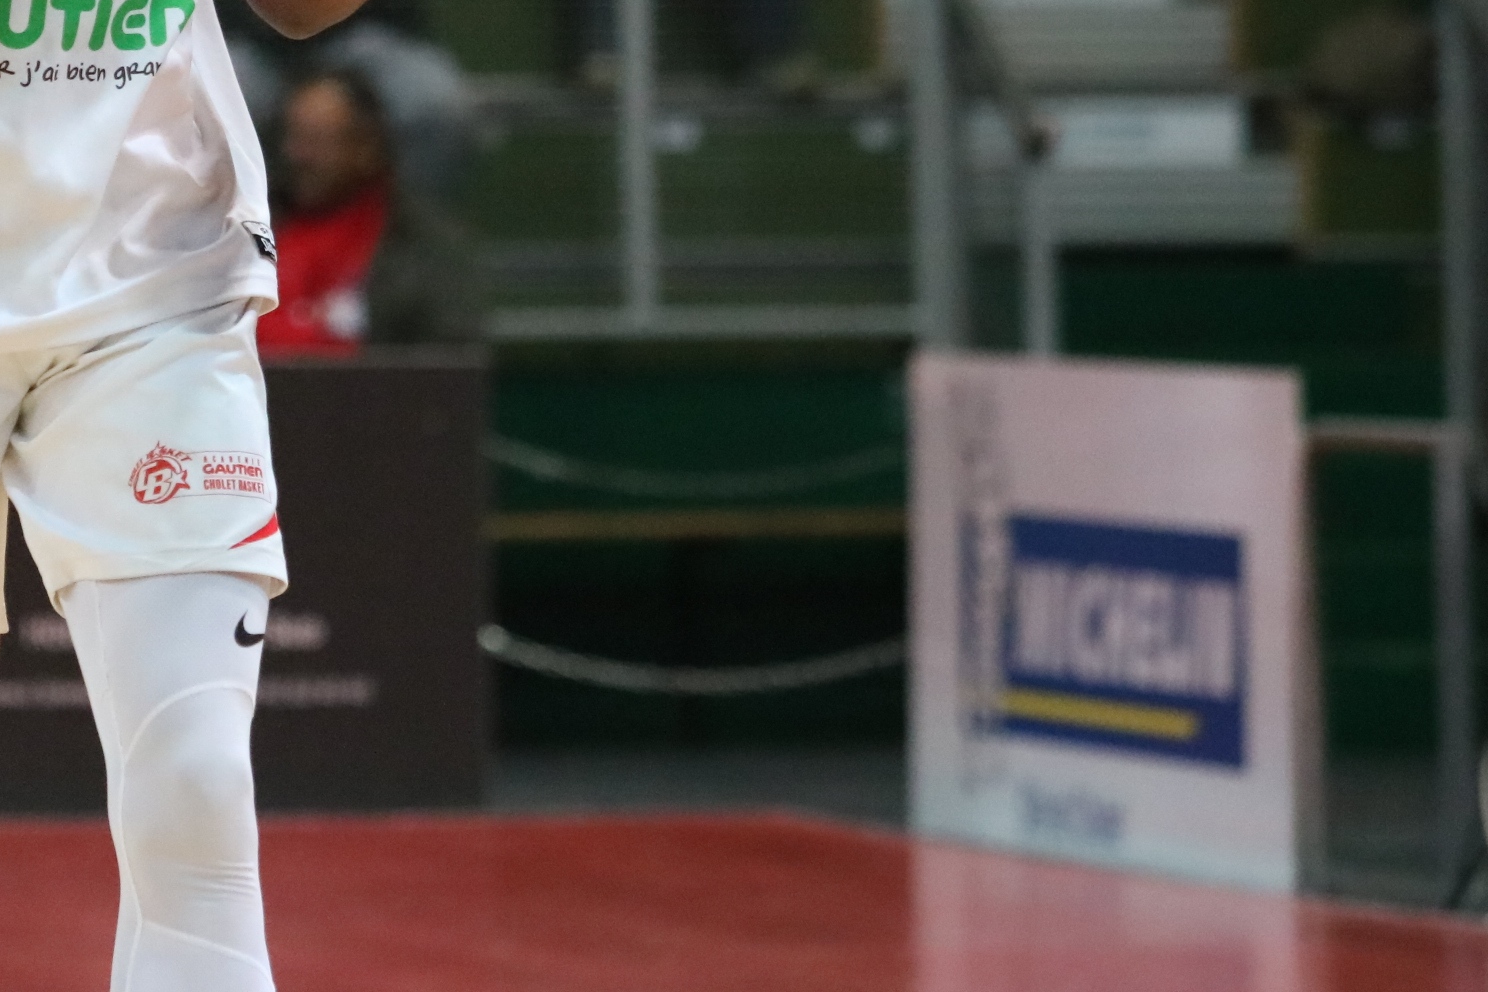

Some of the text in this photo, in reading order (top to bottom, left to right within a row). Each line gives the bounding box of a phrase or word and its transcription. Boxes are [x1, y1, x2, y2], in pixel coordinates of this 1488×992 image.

[20, 60, 60, 88] j'ai
[66, 62, 106, 82] bien
[203, 478, 265, 495] CHOLET BASKET
